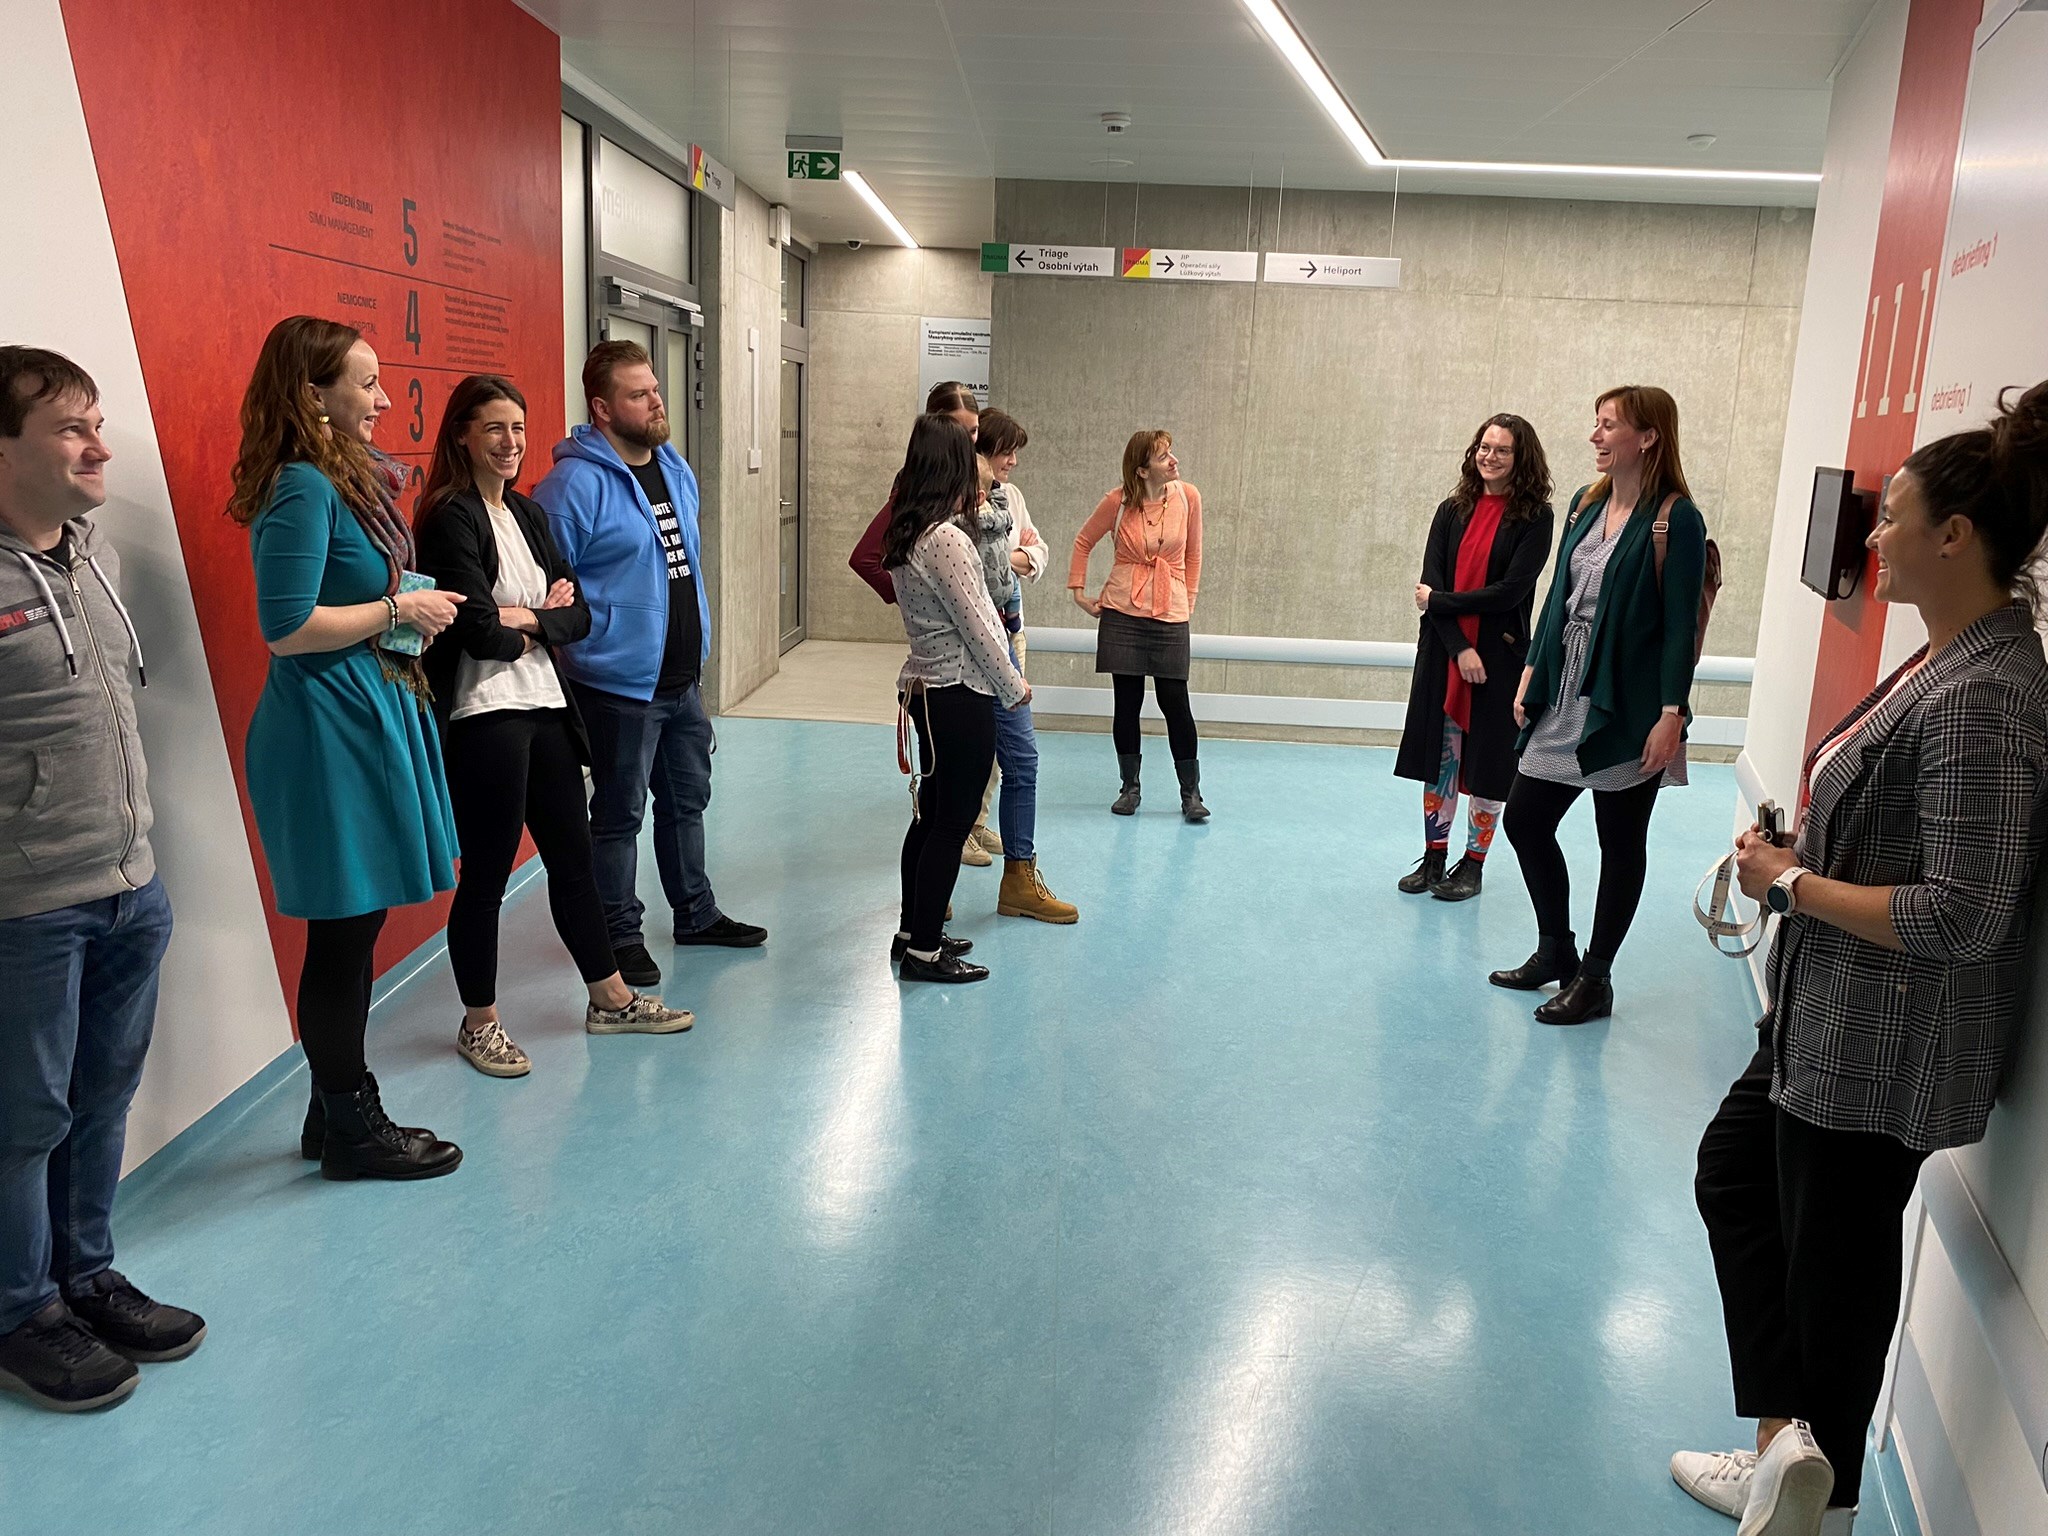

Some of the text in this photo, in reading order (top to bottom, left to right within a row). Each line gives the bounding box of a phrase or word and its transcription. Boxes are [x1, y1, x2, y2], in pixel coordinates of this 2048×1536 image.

[356, 199, 374, 214] SIMU
[309, 211, 374, 239] SIMU MANAGEMENT
[403, 198, 418, 267] 5
[1038, 261, 1099, 273] Osobní výtah
[1039, 248, 1069, 260] Triage
[1951, 232, 1999, 277] debriefing 1
[1323, 265, 1362, 276] Heliport
[337, 292, 377, 310] NEMOCNICE
[406, 290, 421, 355] 4
[1857, 268, 1931, 418] 111
[408, 378, 424, 442] 3
[1931, 382, 1973, 414] debriefing 1
[652, 502, 671, 516] ASTE
